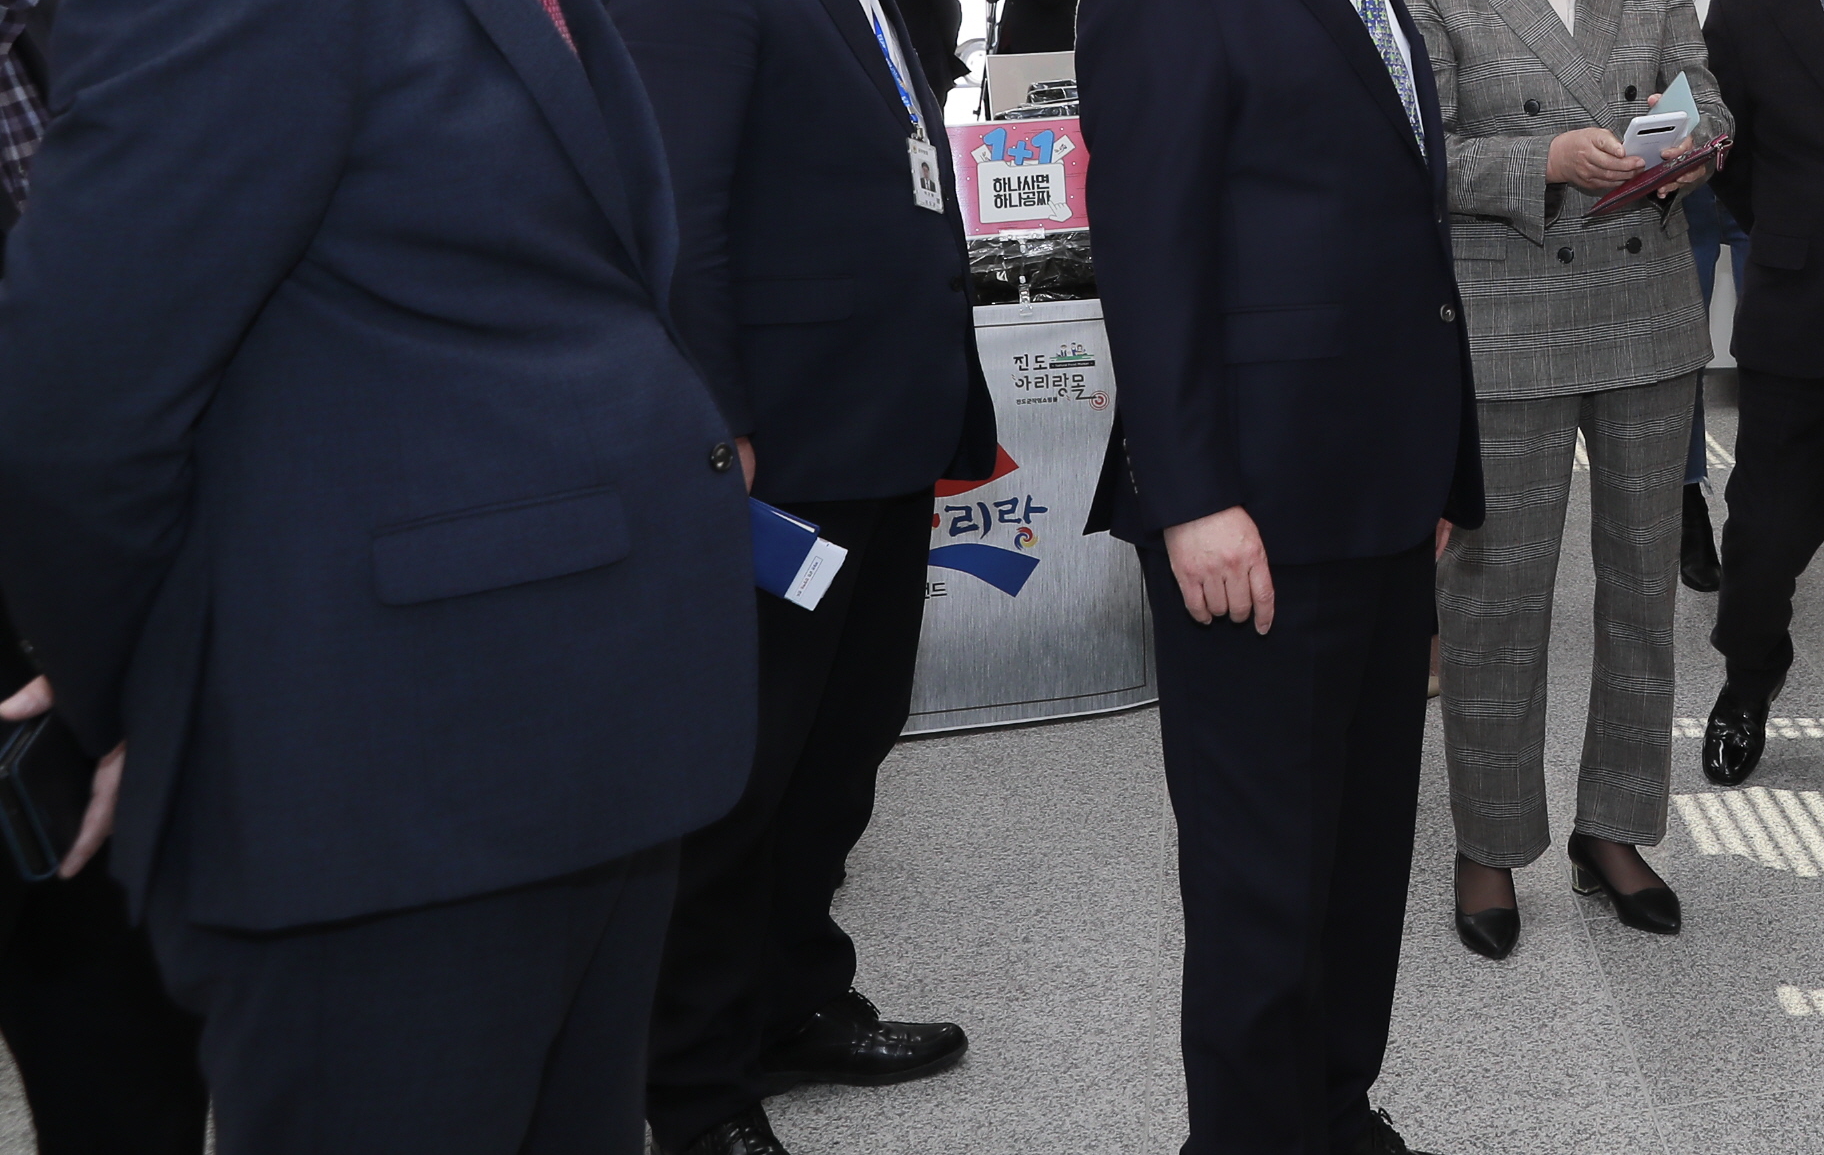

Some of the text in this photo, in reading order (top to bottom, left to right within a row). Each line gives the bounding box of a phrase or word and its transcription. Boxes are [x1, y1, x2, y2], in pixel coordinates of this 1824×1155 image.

[983, 127, 1055, 165] 1+1
[992, 173, 1050, 193] 하나사면
[993, 190, 1051, 209] 하나공짜
[1013, 353, 1048, 372] 진도
[1014, 372, 1097, 401] 아리랑몰
[932, 494, 1048, 550] 리랑
